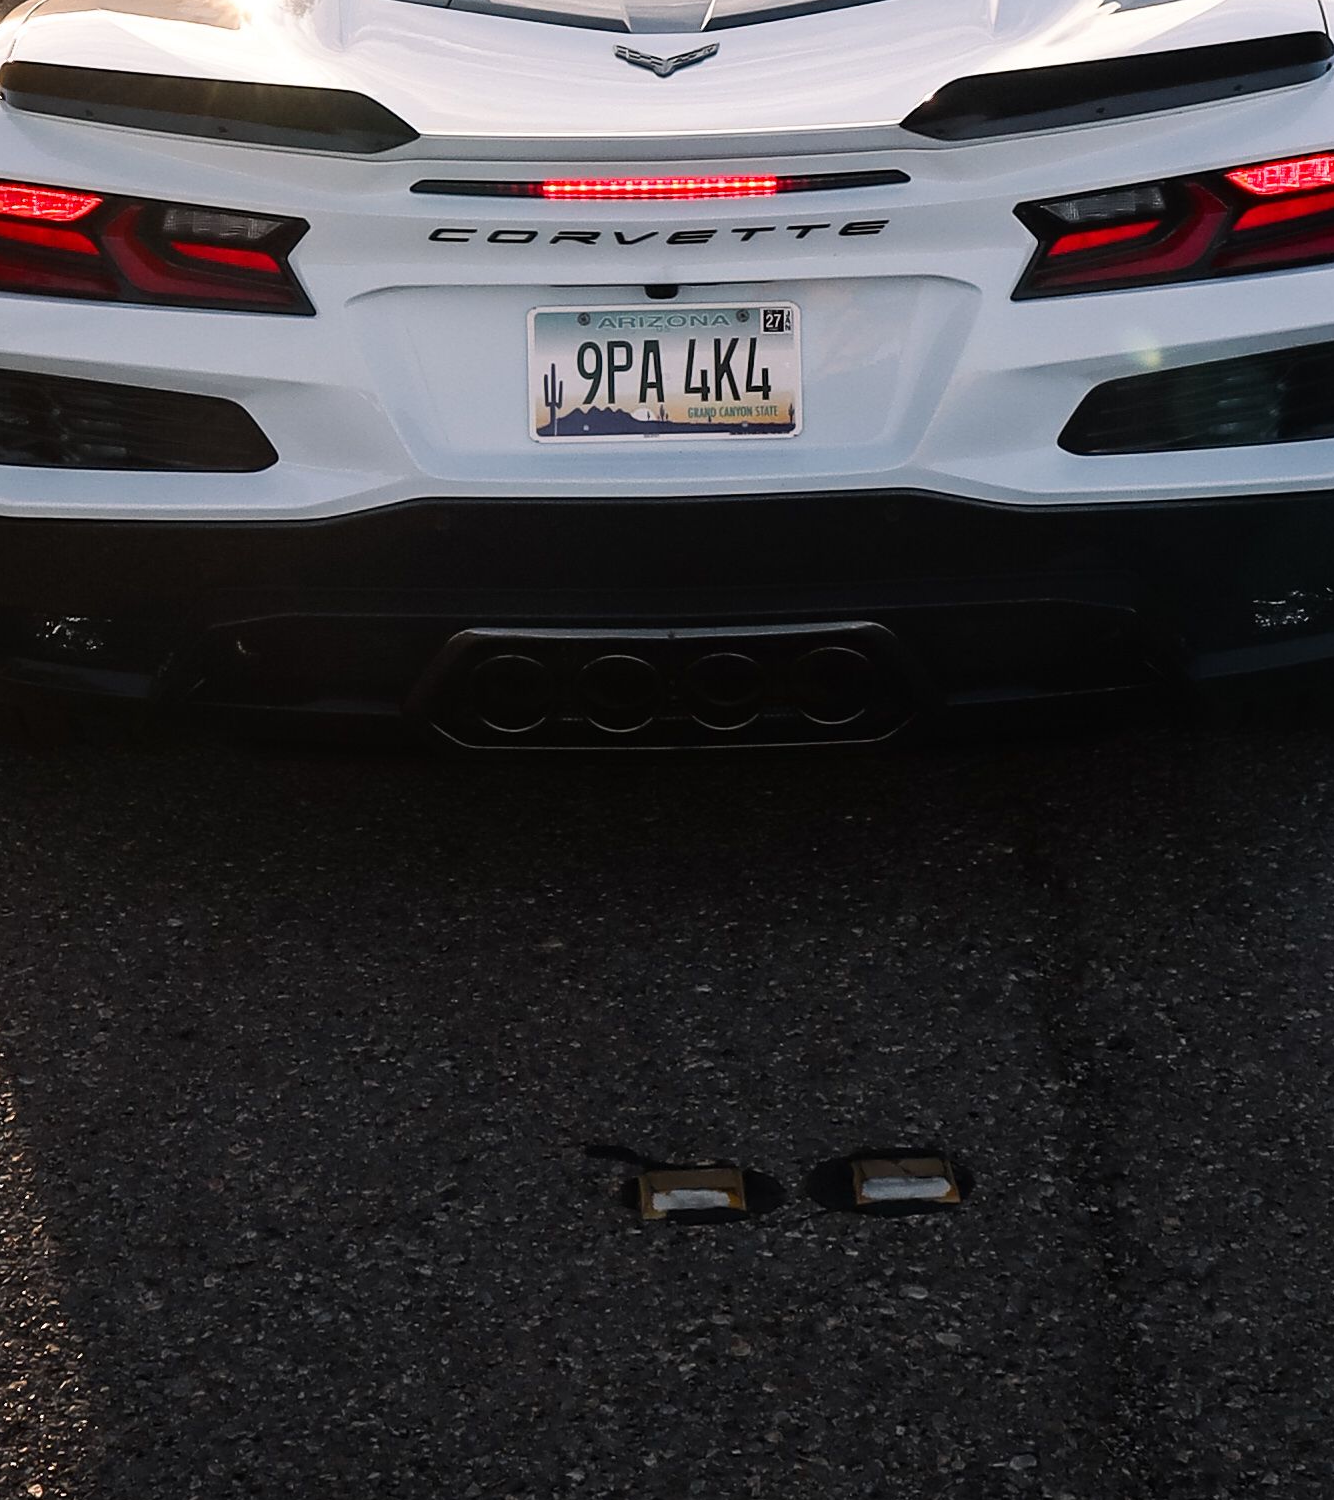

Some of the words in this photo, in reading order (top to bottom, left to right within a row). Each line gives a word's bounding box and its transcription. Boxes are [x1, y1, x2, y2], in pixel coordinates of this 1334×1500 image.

[427, 219, 891, 246] CORVETTE
[597, 313, 731, 330] ARIZONA
[765, 313, 782, 328] 27
[576, 339, 665, 405] 9PA
[684, 337, 772, 402] 4K4
[687, 406, 717, 418] GRAND
[719, 405, 753, 417] CANYON
[755, 404, 779, 416] STATE
